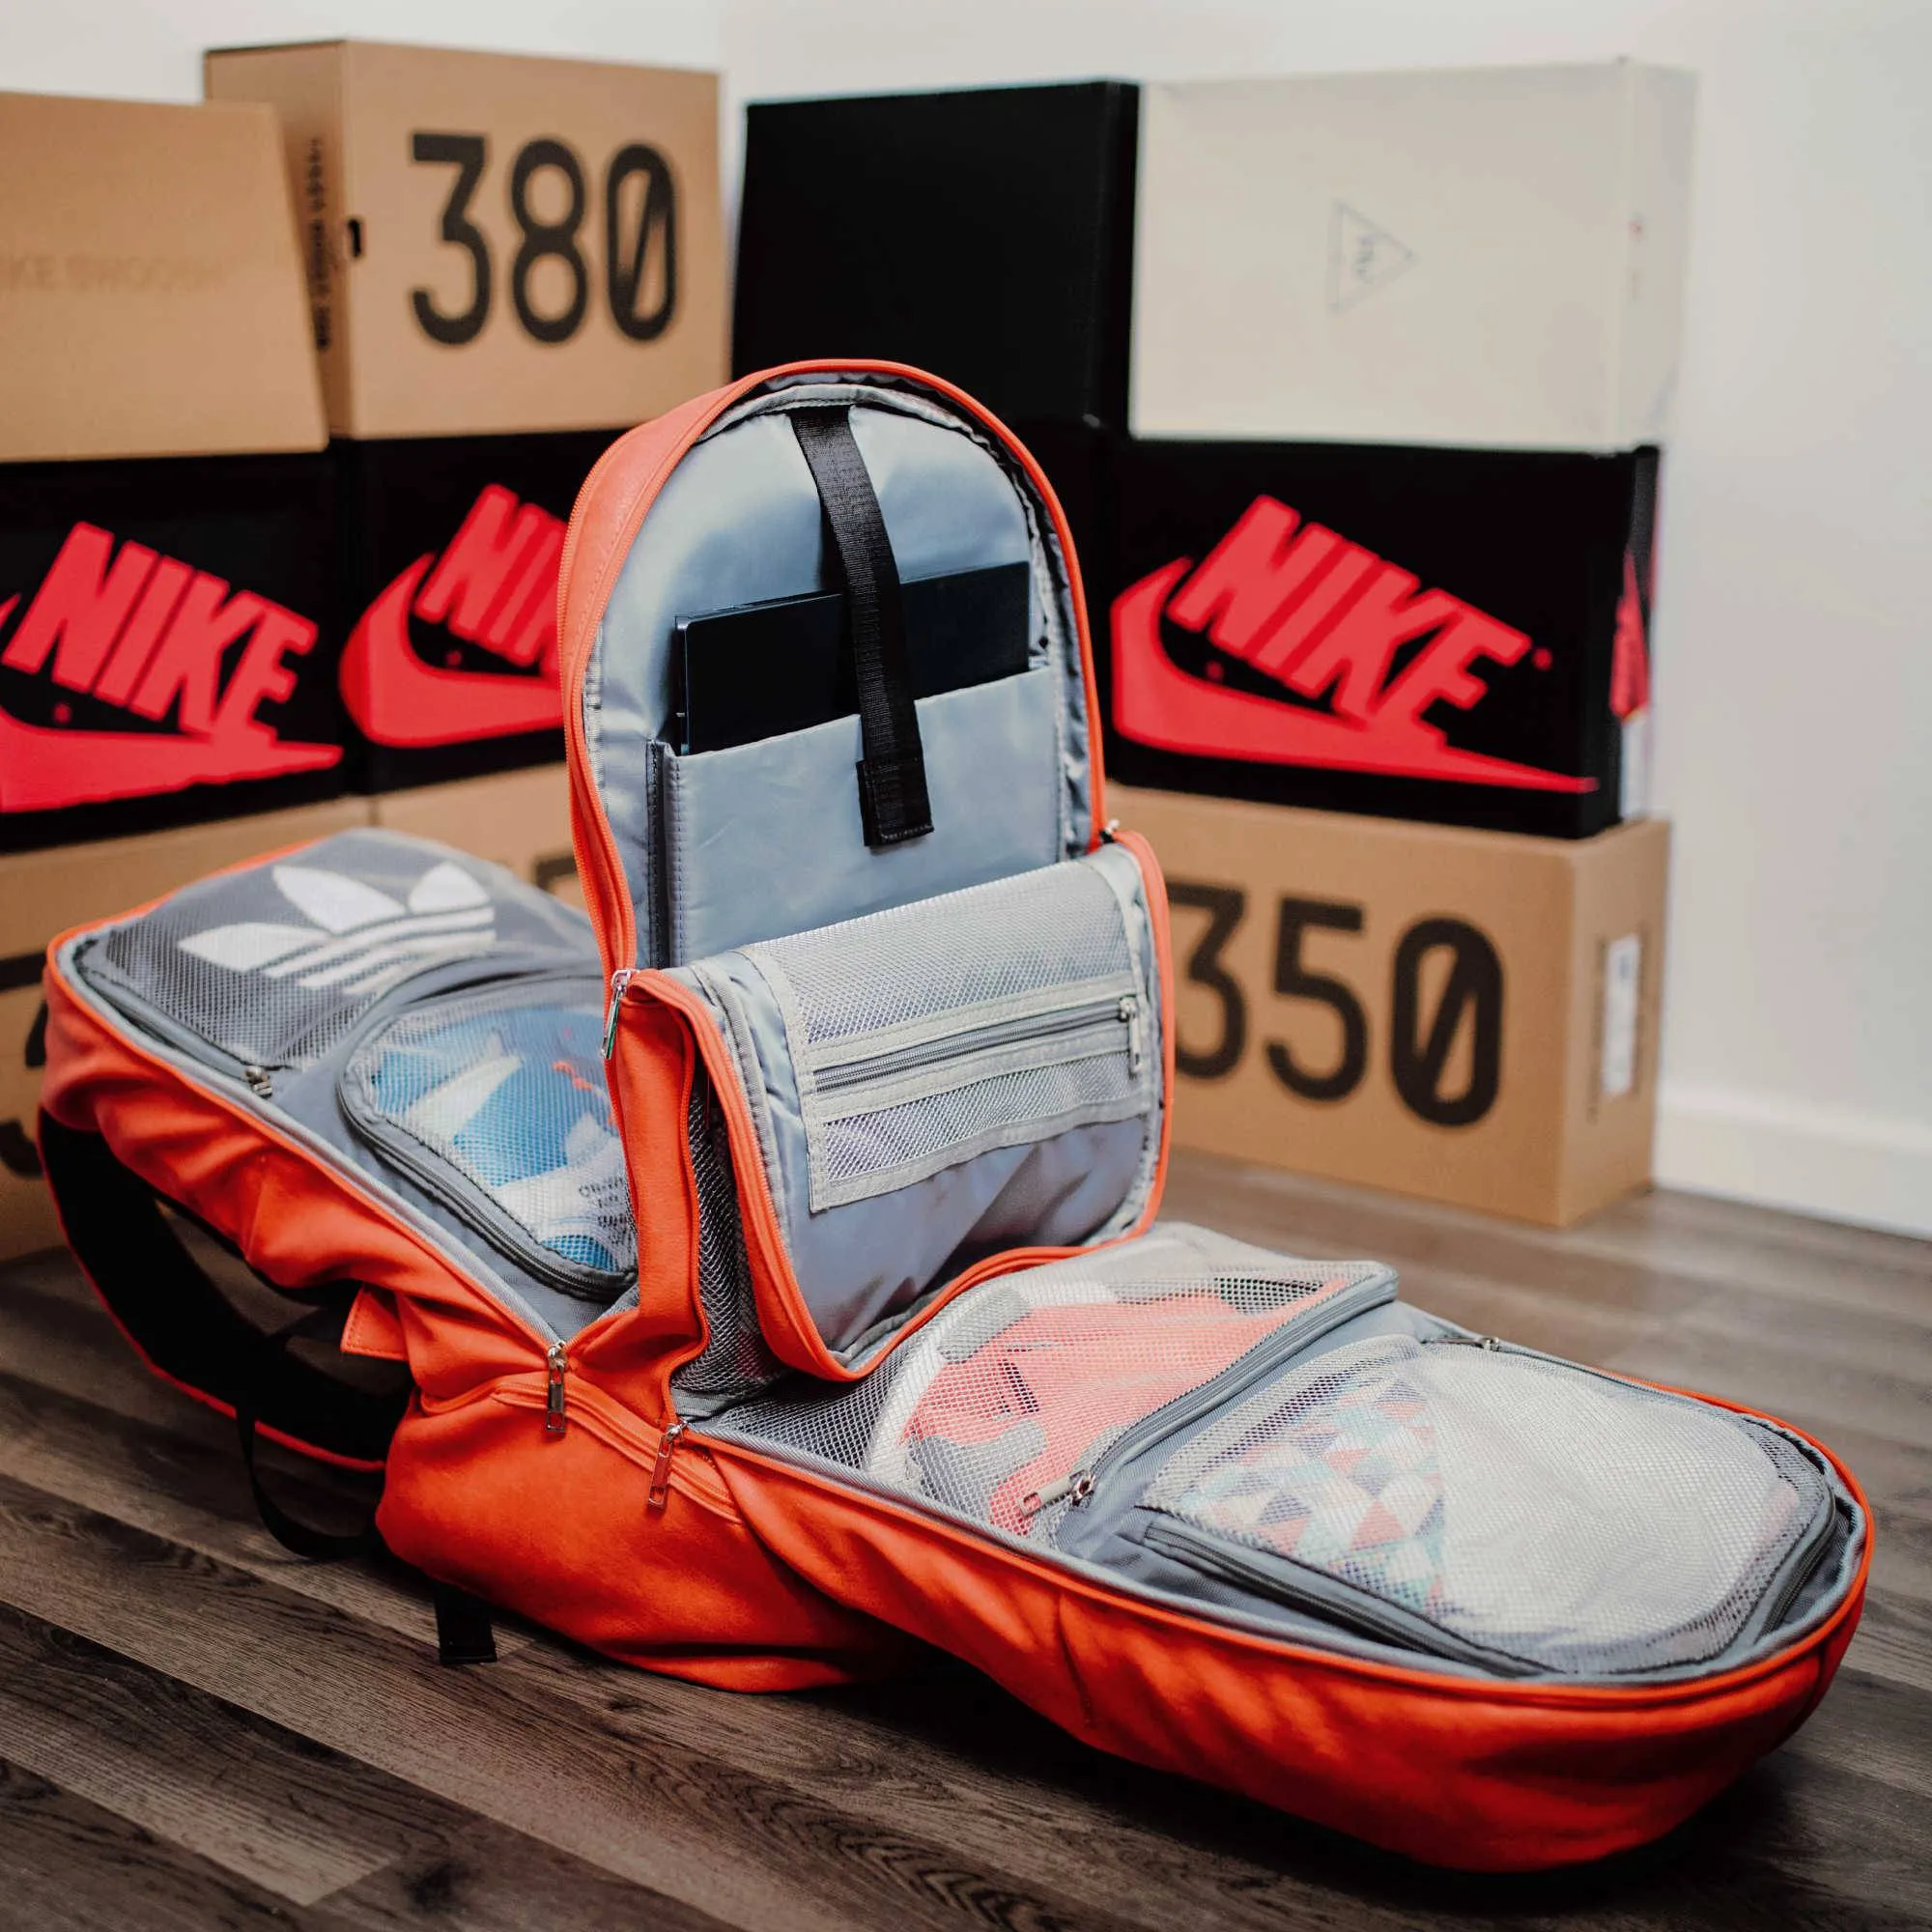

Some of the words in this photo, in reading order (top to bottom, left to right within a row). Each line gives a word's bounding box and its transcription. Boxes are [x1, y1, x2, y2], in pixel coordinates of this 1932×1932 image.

[411, 131, 678, 346] 380
[1, 521, 319, 748] NIKE
[1167, 494, 1533, 746] NIKE
[1167, 877, 1505, 1128] 350
